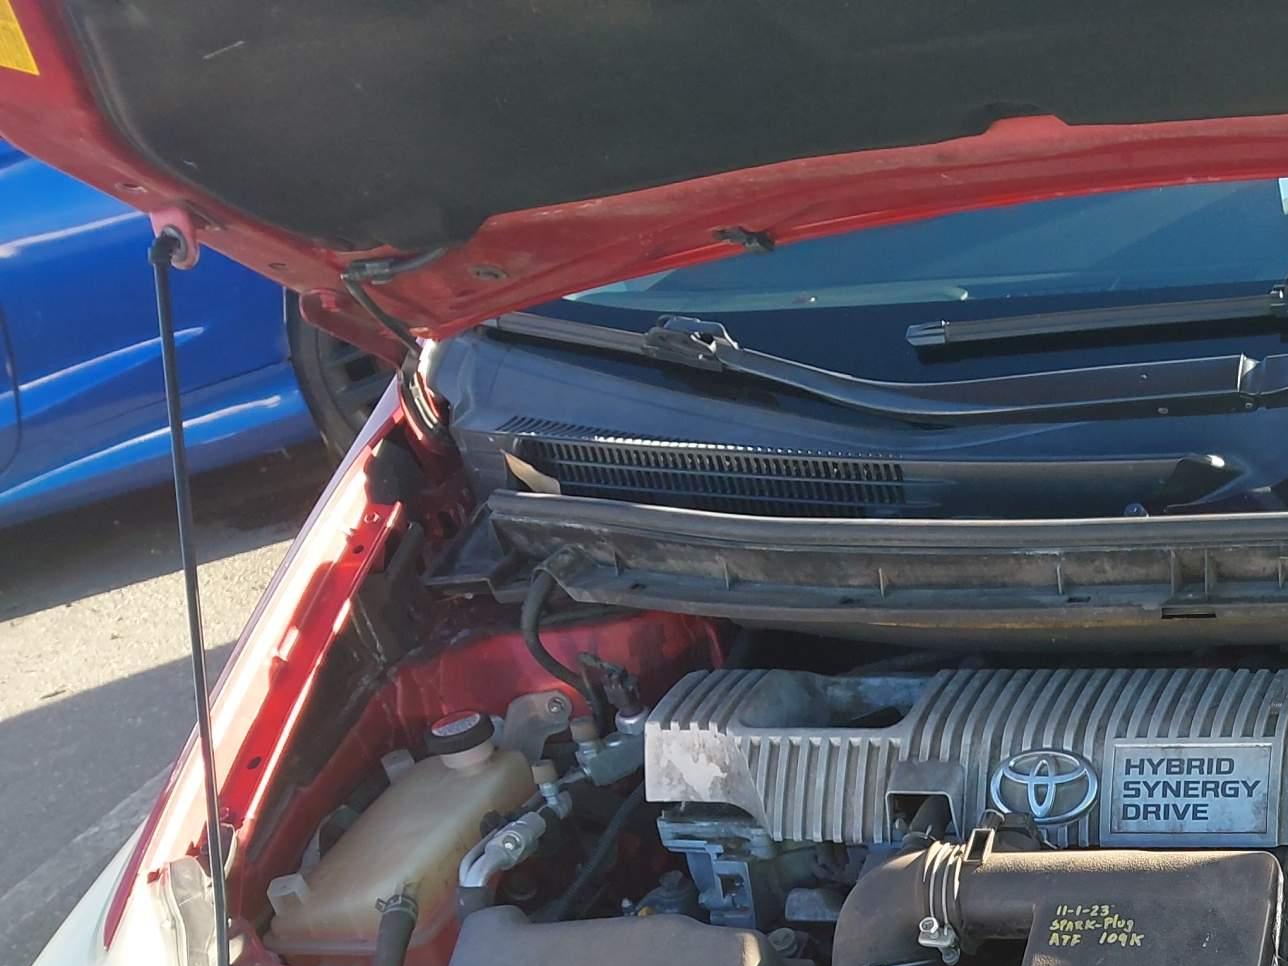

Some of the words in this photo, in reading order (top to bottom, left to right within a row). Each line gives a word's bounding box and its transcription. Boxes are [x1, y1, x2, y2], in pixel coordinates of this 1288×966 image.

[1124, 758, 1235, 776] HYBRID
[1122, 780, 1261, 799] SYNERGY
[1121, 803, 1209, 821] DRIVE
[1056, 904, 1110, 917] 11-1-23
[1099, 931, 1145, 947] 109K
